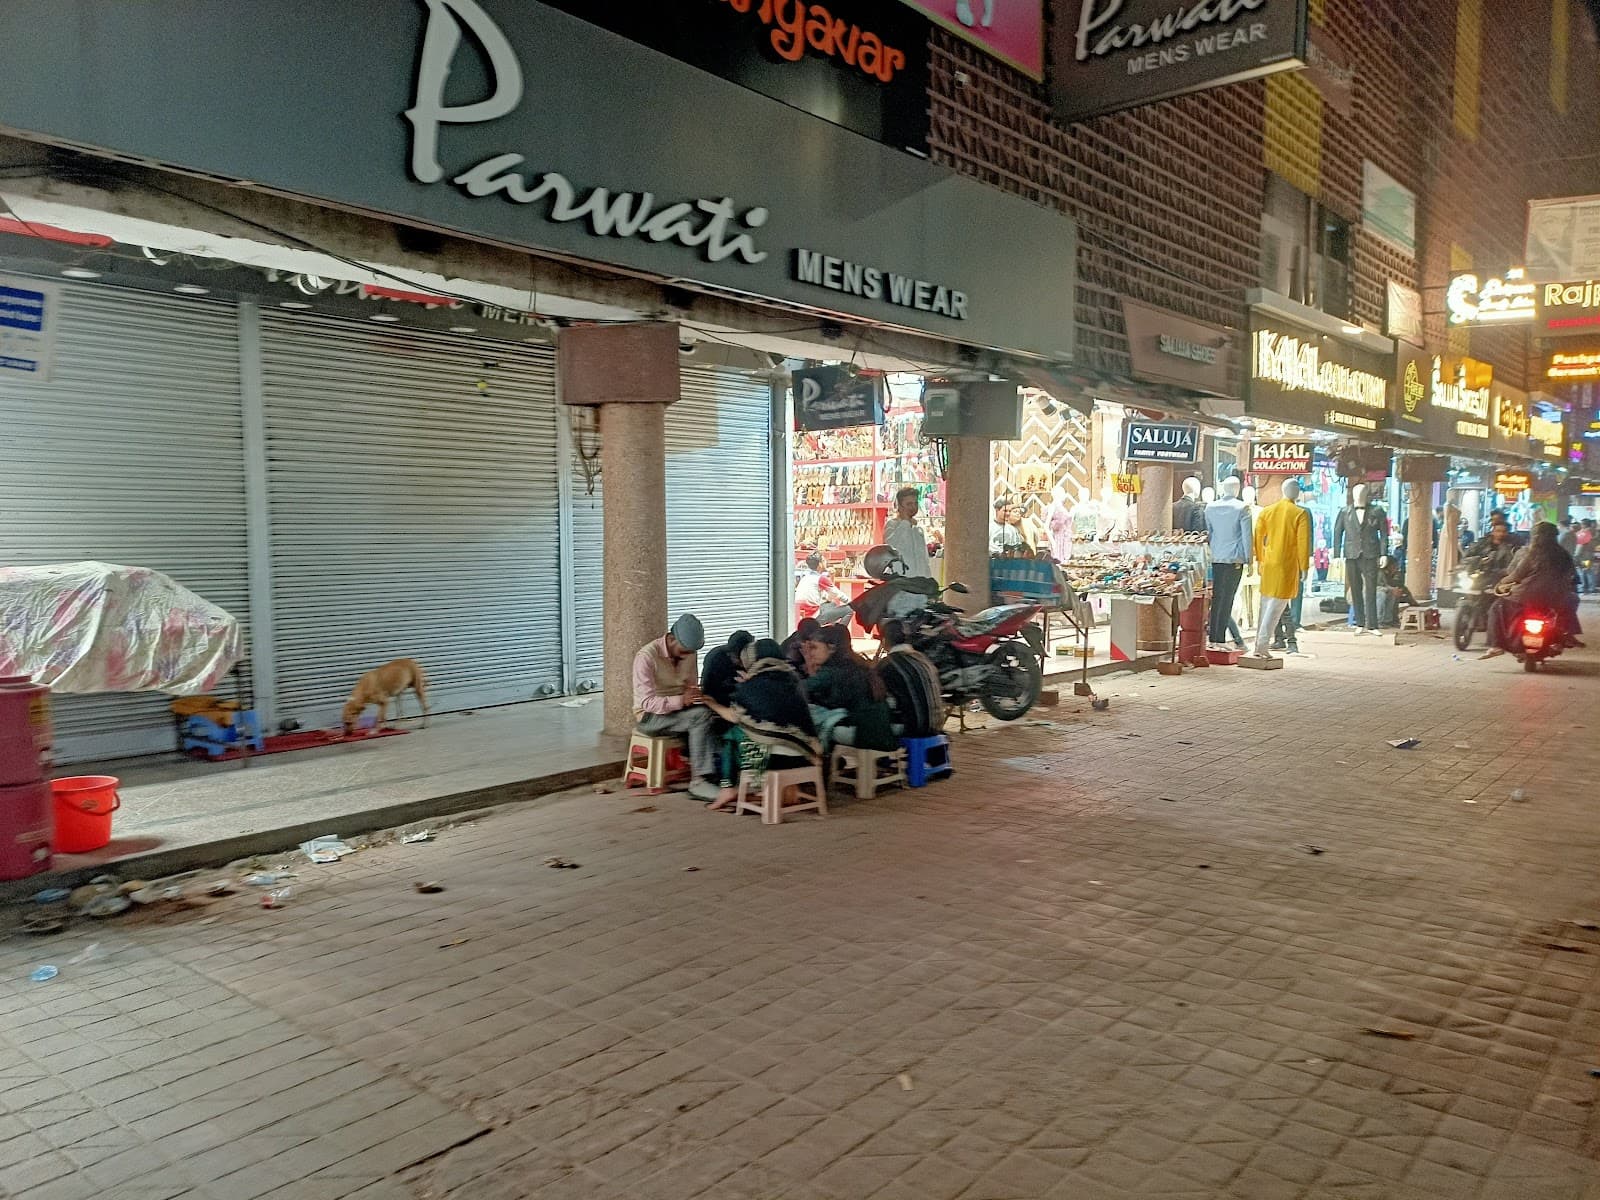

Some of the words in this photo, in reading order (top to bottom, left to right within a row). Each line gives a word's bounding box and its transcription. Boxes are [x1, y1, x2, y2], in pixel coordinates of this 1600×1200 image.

[1126, 44, 1191, 75] MENS
[1194, 22, 1268, 56] WEAR
[404, 0, 769, 264] Parwati
[797, 247, 883, 300] MENS
[888, 271, 969, 320] WEAR
[1131, 427, 1192, 448] SALUJA
[1253, 443, 1310, 460] KAJAL
[1252, 461, 1307, 471] COLLECTION
